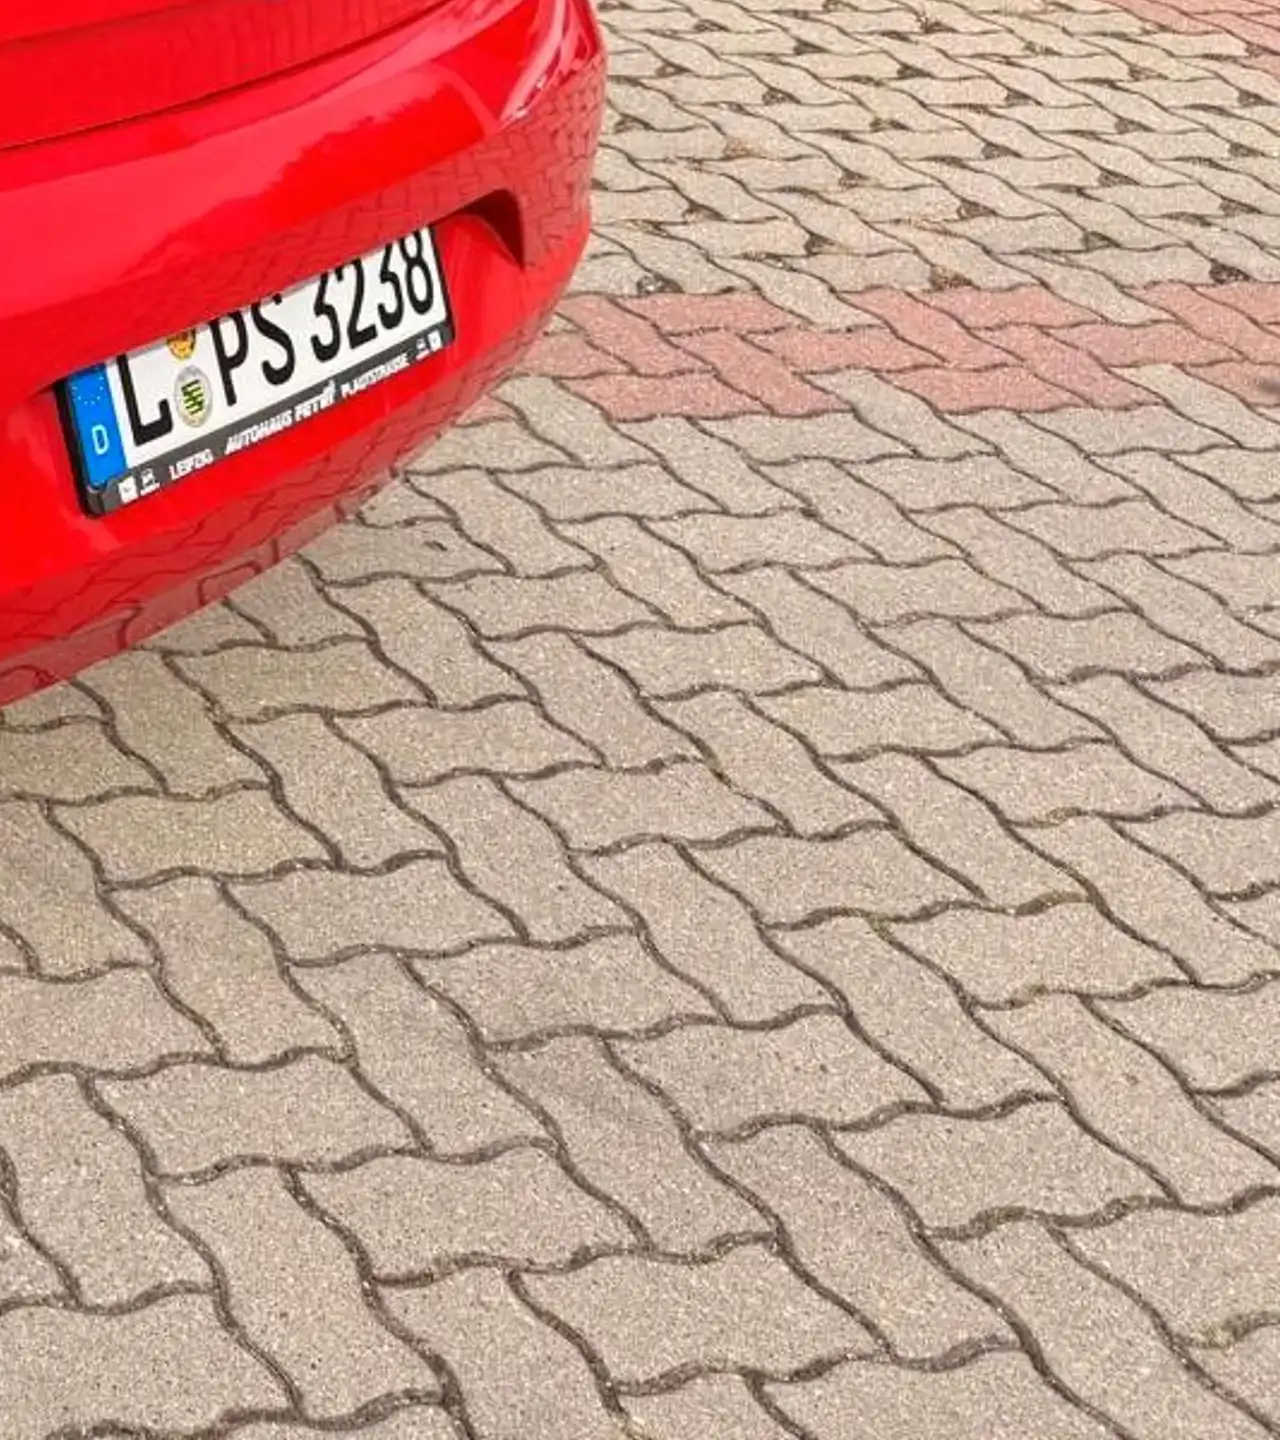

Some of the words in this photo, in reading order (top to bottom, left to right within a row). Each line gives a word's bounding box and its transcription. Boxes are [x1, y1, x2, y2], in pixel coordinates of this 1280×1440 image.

[91, 424, 111, 457] D
[118, 352, 174, 448] L
[207, 298, 296, 408] PS
[310, 228, 435, 363] 3238
[167, 448, 215, 482] LEIPZIG
[224, 410, 294, 456] AUTOHAUS
